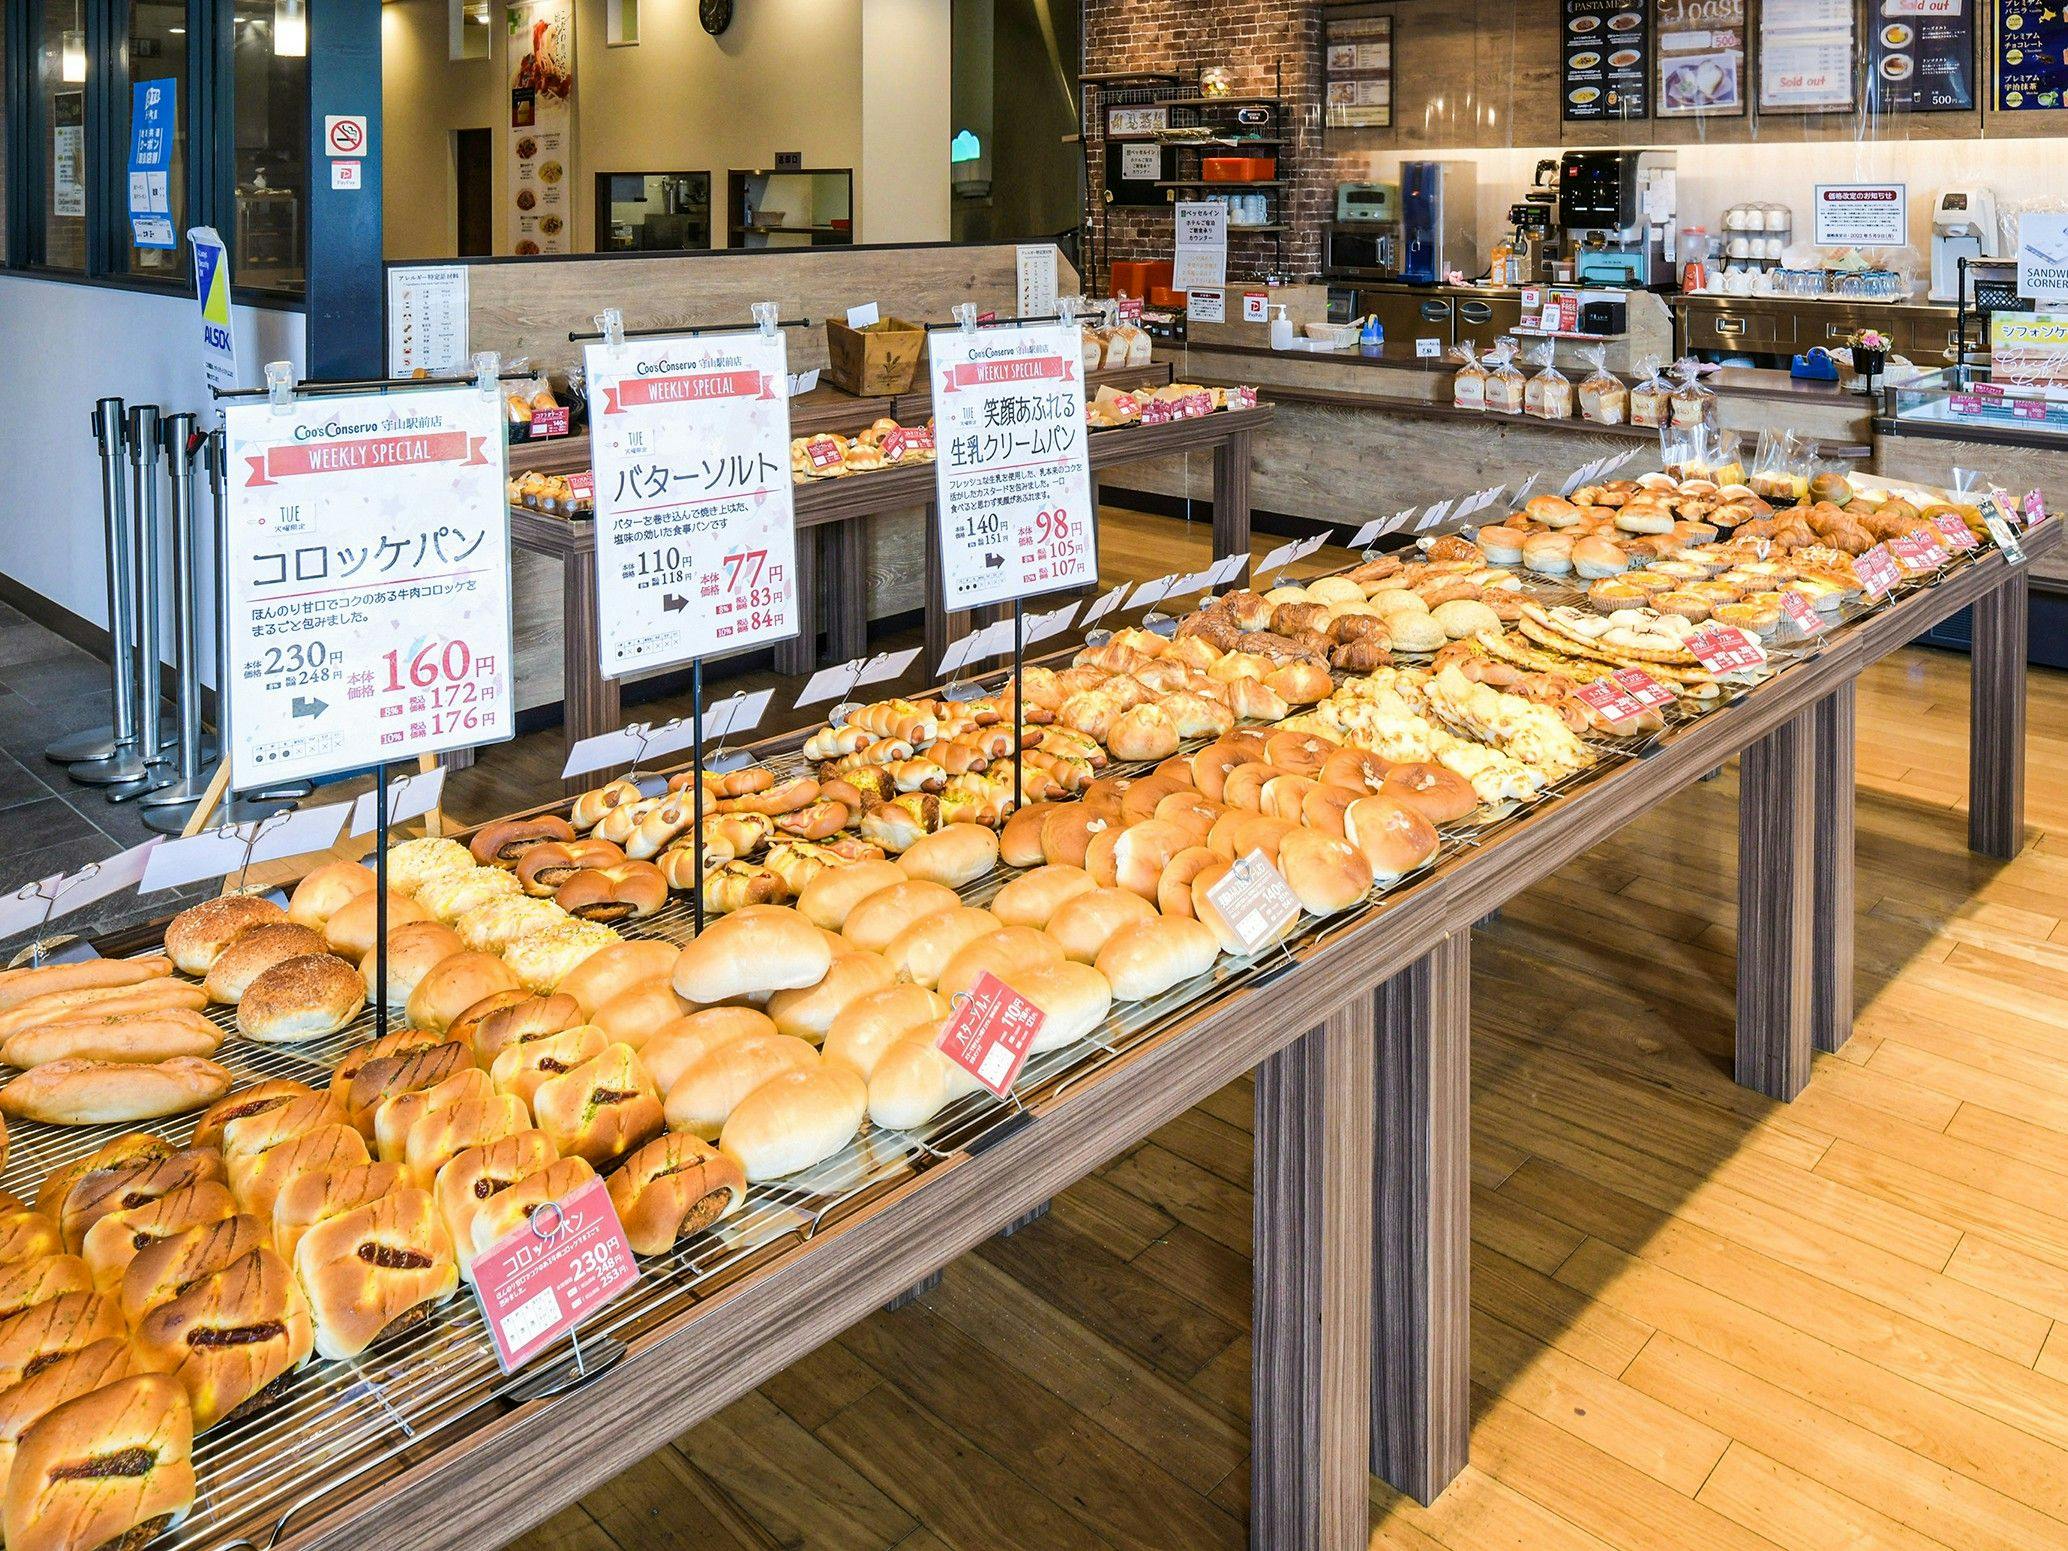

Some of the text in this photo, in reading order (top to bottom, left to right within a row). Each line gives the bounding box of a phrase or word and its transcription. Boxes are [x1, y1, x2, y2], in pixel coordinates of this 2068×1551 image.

[2004, 32, 2040, 41] プレミアム
[2004, 41, 2043, 49] チョコレート
[1780, 75, 1826, 87] Sold out
[2004, 74, 2040, 83] プレミアム
[1828, 192, 1893, 200] 価格改定のお知らせ
[204, 325, 231, 351] ALSOK
[977, 362, 1044, 381] WEEKLY SPECIAL
[648, 377, 735, 401] WEEKLY SPECIAL
[963, 407, 974, 419] TUE
[984, 393, 1075, 428] 笑顔あふれる
[381, 416, 442, 432] 守山駅前店
[628, 431, 643, 446] TUE
[951, 425, 1076, 467] 生乳クリームパン
[309, 439, 431, 470] WEEKLY SPECIAL
[614, 452, 778, 502] バターソルト
[280, 505, 300, 522] TUE
[613, 518, 729, 545] 塩味の効いた食事パンです
[253, 526, 486, 586] コロッケパン
[700, 572, 720, 585] 本体
[700, 585, 720, 598] 価格
[252, 580, 477, 621] ほんのり甘口でコクのある牛肉コロッケを
[252, 611, 369, 638] まるごと包みました。
[244, 660, 262, 670] 本体
[244, 669, 262, 679] 価格
[349, 670, 375, 685] 本体
[346, 684, 375, 700] 価格
[956, 993, 991, 1046] バターソルト
[569, 1235, 620, 1282] 230円
